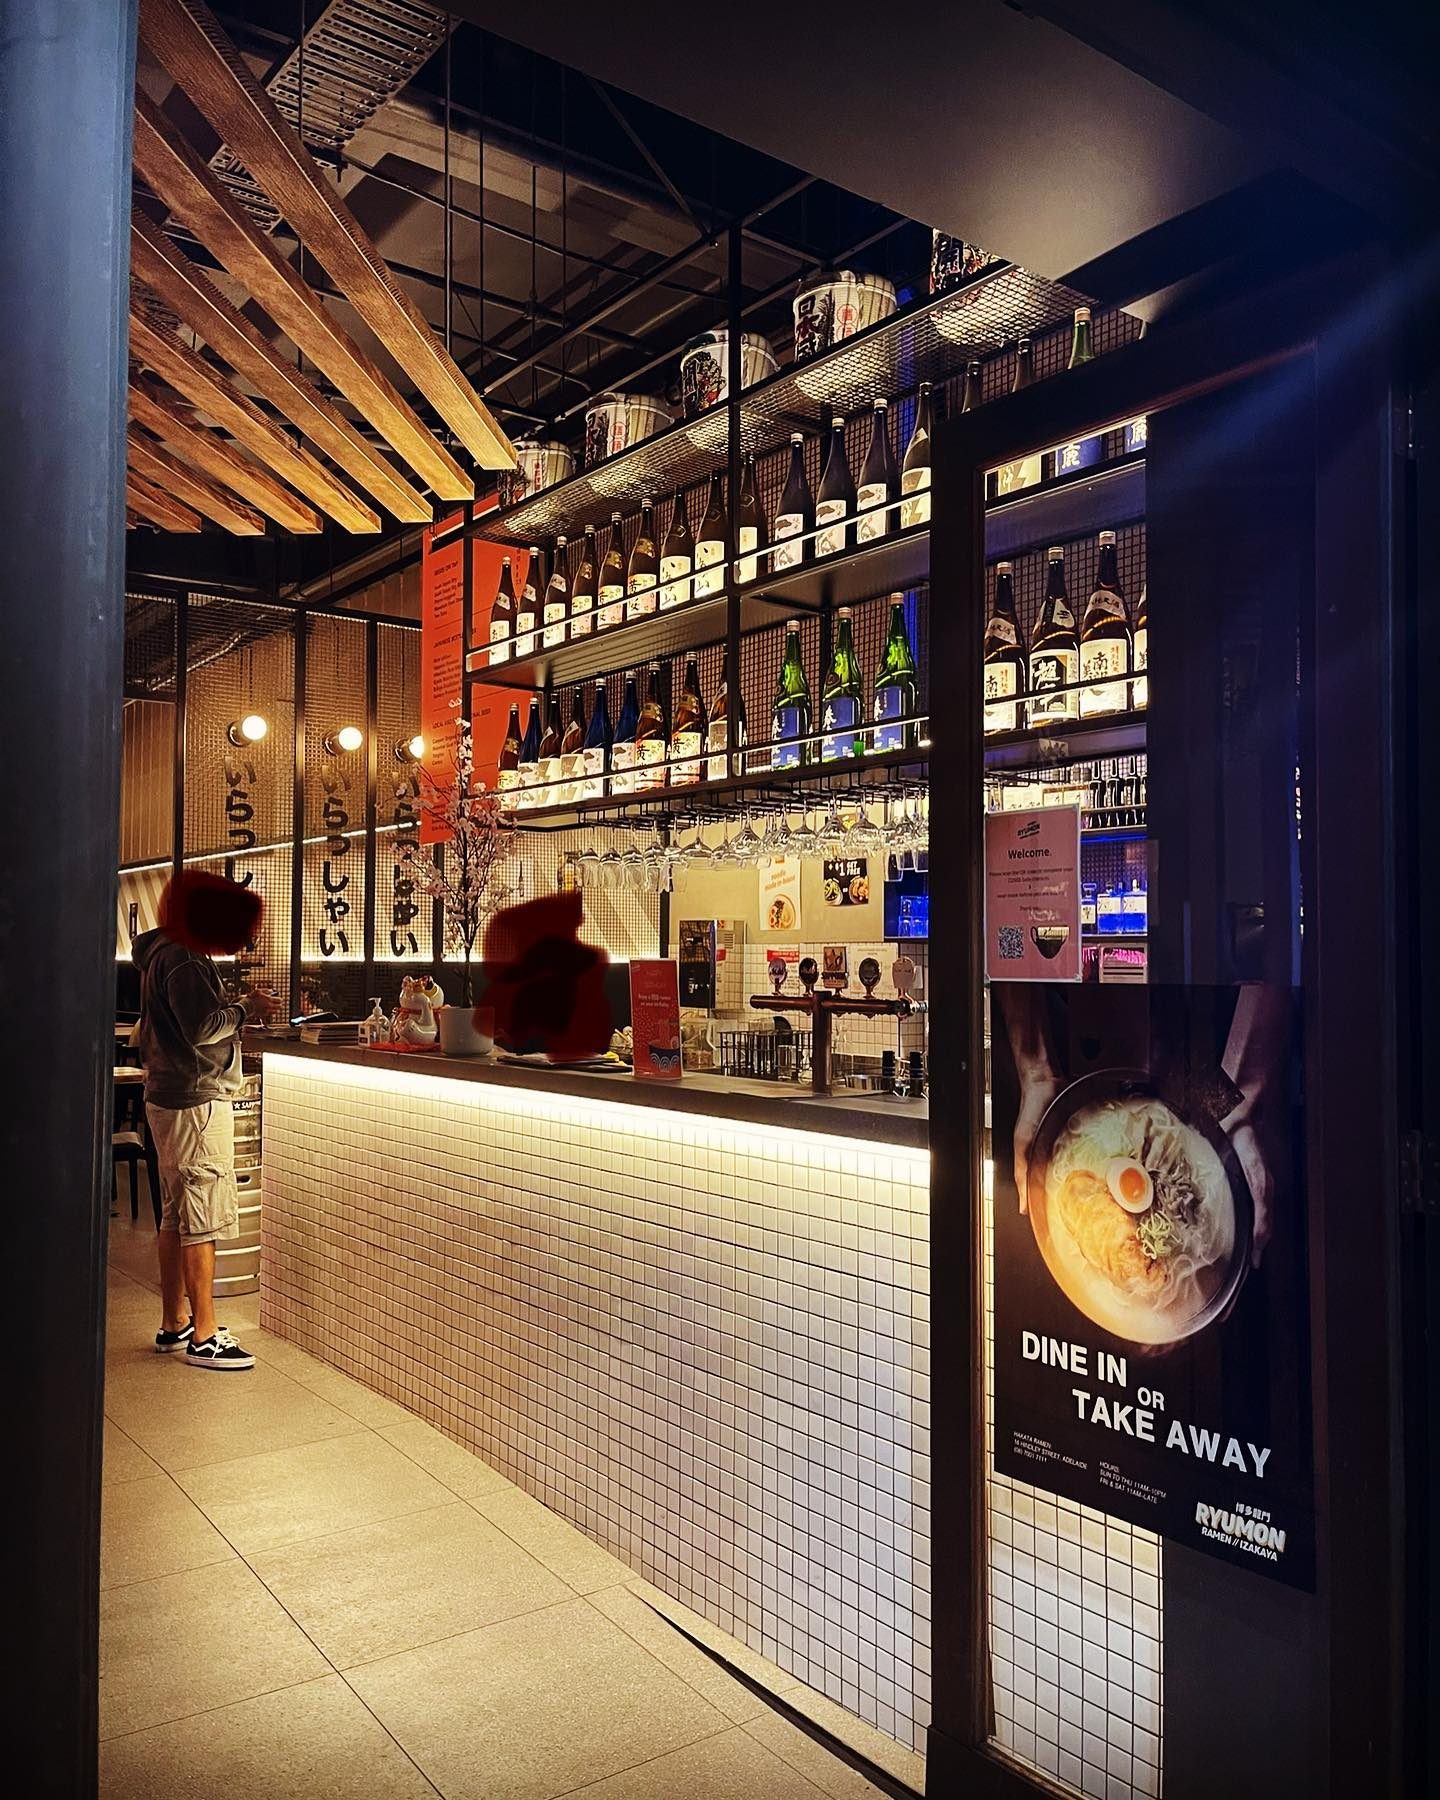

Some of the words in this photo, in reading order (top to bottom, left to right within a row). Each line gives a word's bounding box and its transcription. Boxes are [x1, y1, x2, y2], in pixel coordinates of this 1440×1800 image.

[318, 764, 351, 957] いらっしゃい
[1022, 1331, 1088, 1376] DINE
[1098, 1352, 1127, 1387] IN
[1138, 1387, 1165, 1411] OR
[1072, 1389, 1155, 1442] TAKE
[1166, 1420, 1271, 1478] AWAY
[1063, 1456, 1088, 1469] ADELAIDE
[1100, 1469, 1112, 1480] SUN
[1195, 1501, 1286, 1552] RYUMON
[1201, 1526, 1232, 1545] RAMEN
[1240, 1540, 1278, 1562] IZAKAYA
